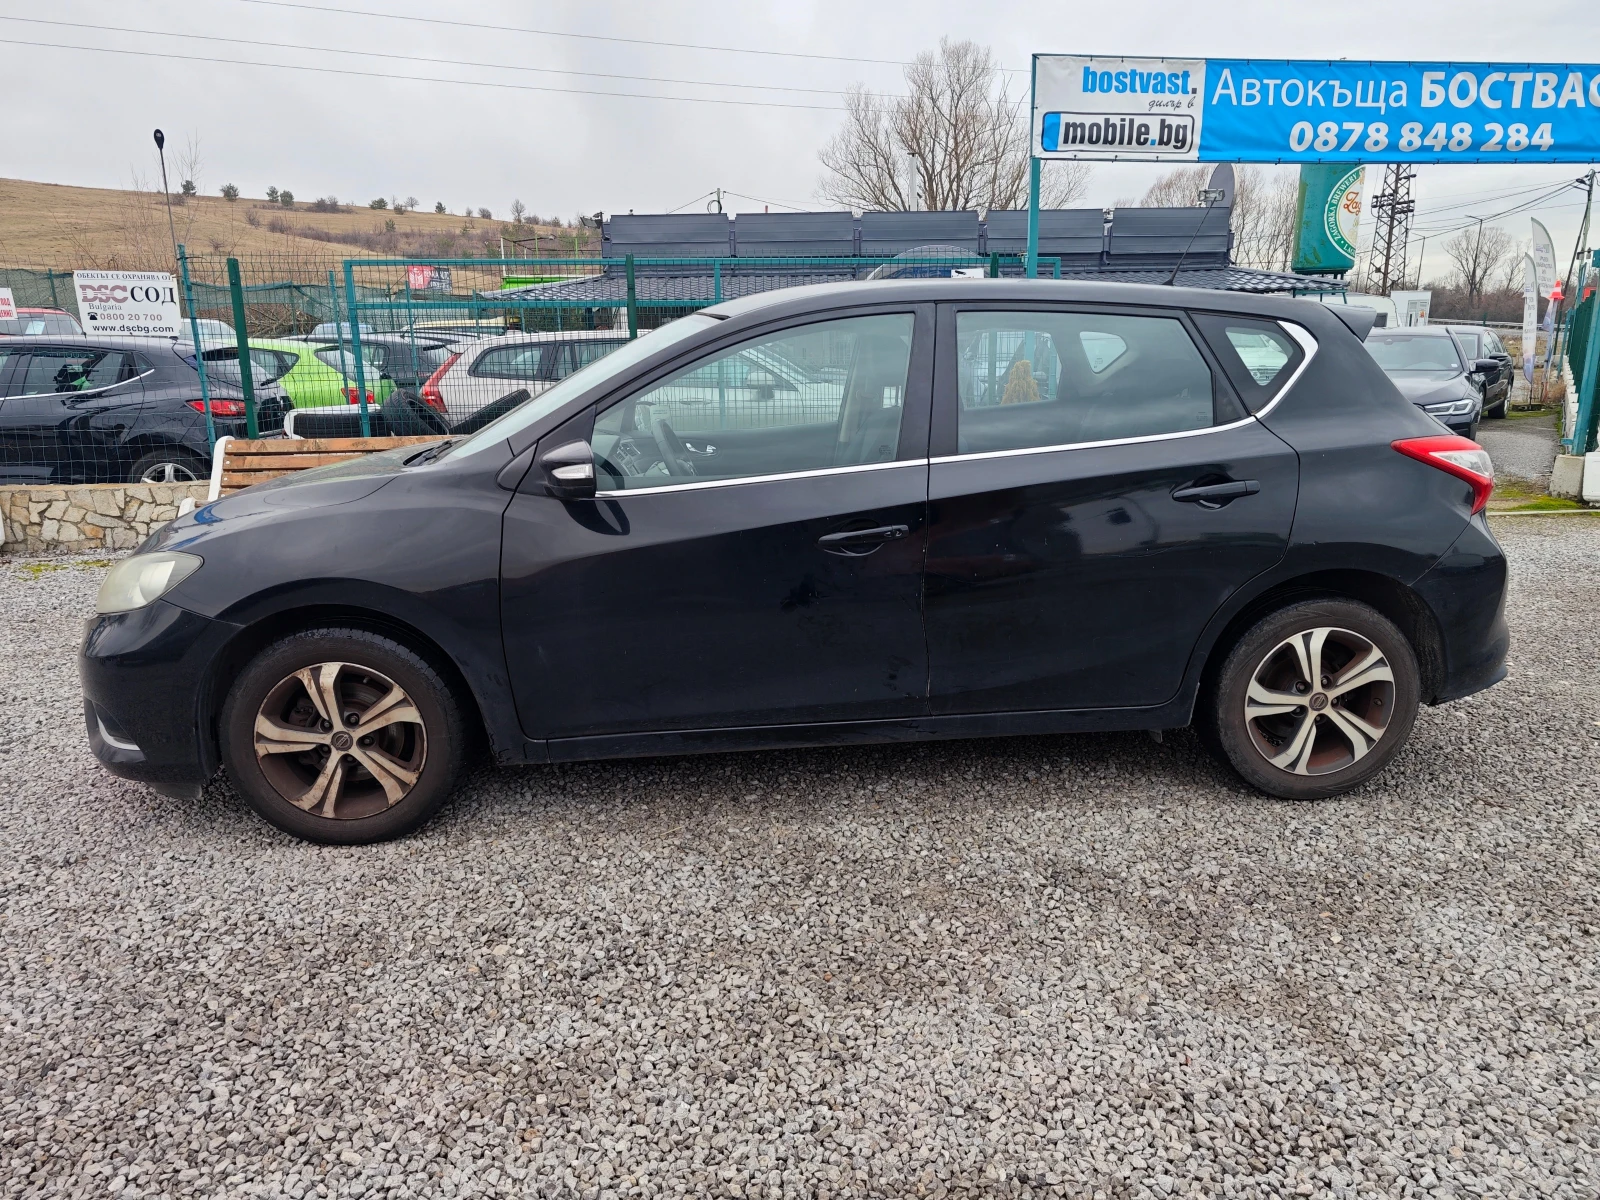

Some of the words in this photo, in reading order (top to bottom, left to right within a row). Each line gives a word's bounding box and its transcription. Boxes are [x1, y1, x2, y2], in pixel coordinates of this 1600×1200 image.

[1082, 66, 1197, 95] bostvast.
[1211, 68, 1407, 115] Автокъща
[1148, 99, 1182, 111] дилър
[1063, 117, 1188, 150] mobile.bg
[1289, 121, 1389, 152] 0878
[1398, 122, 1473, 152] 848
[1480, 122, 1554, 152] 284
[1331, 173, 1358, 204] BREWERY
[1328, 206, 1342, 241] ZAGORKA
[79, 284, 129, 303] DSC
[130, 285, 176, 306] СОД
[88, 302, 122, 311] Bulgaria
[92, 325, 174, 334] www.dscbg.com
[100, 312, 125, 321] 0800
[127, 313, 140, 321] 20
[143, 313, 163, 321] 700
